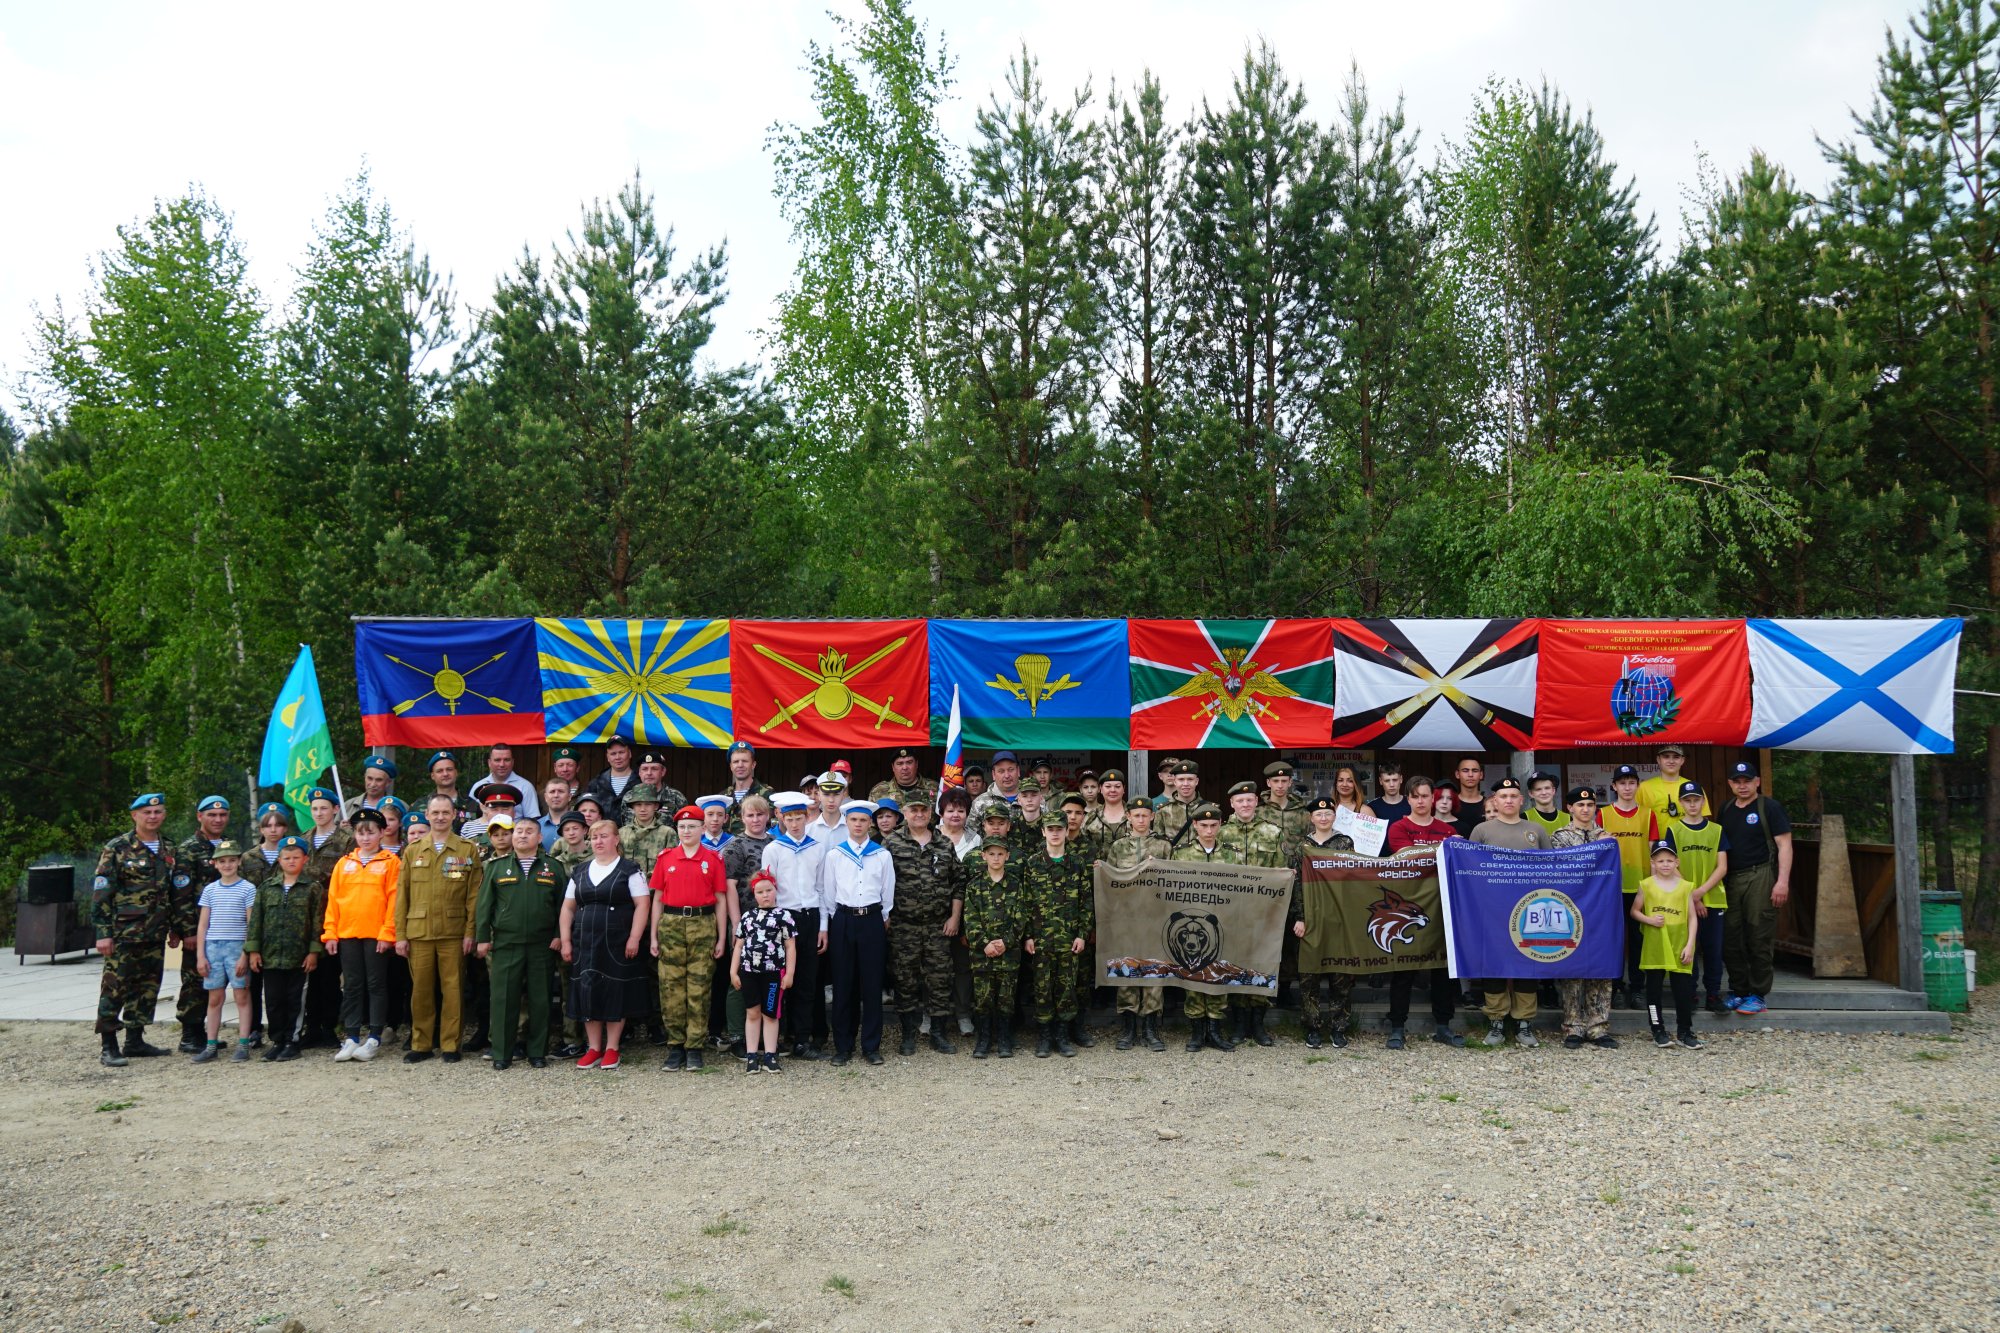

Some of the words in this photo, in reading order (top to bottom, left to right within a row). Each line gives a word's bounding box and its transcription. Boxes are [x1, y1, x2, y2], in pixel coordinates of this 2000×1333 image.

[1630, 653, 1675, 664] Боевое
[1449, 841, 1511, 853] ГОСУДАРСТВЕННОЕ
[1681, 844, 1713, 853] DEMIX
[1492, 853, 1555, 862] ОБРАЗОВАТЕЛЬНОЕ
[1556, 852, 1597, 862] УЧРЕЖДЕНИЕ
[1480, 862, 1553, 870] СВЕРДЛОВСКОЙ
[1377, 870, 1422, 879] «РЫСЬ»
[1110, 877, 1254, 894] Военно-Патриотический
[1257, 884, 1286, 898] Клуб
[1652, 906, 1682, 916] DEMIX
[1320, 956, 1361, 968] СТУПАЙ
[1364, 956, 1388, 967] ТИХО
[766, 982, 778, 1012] FROZEN
